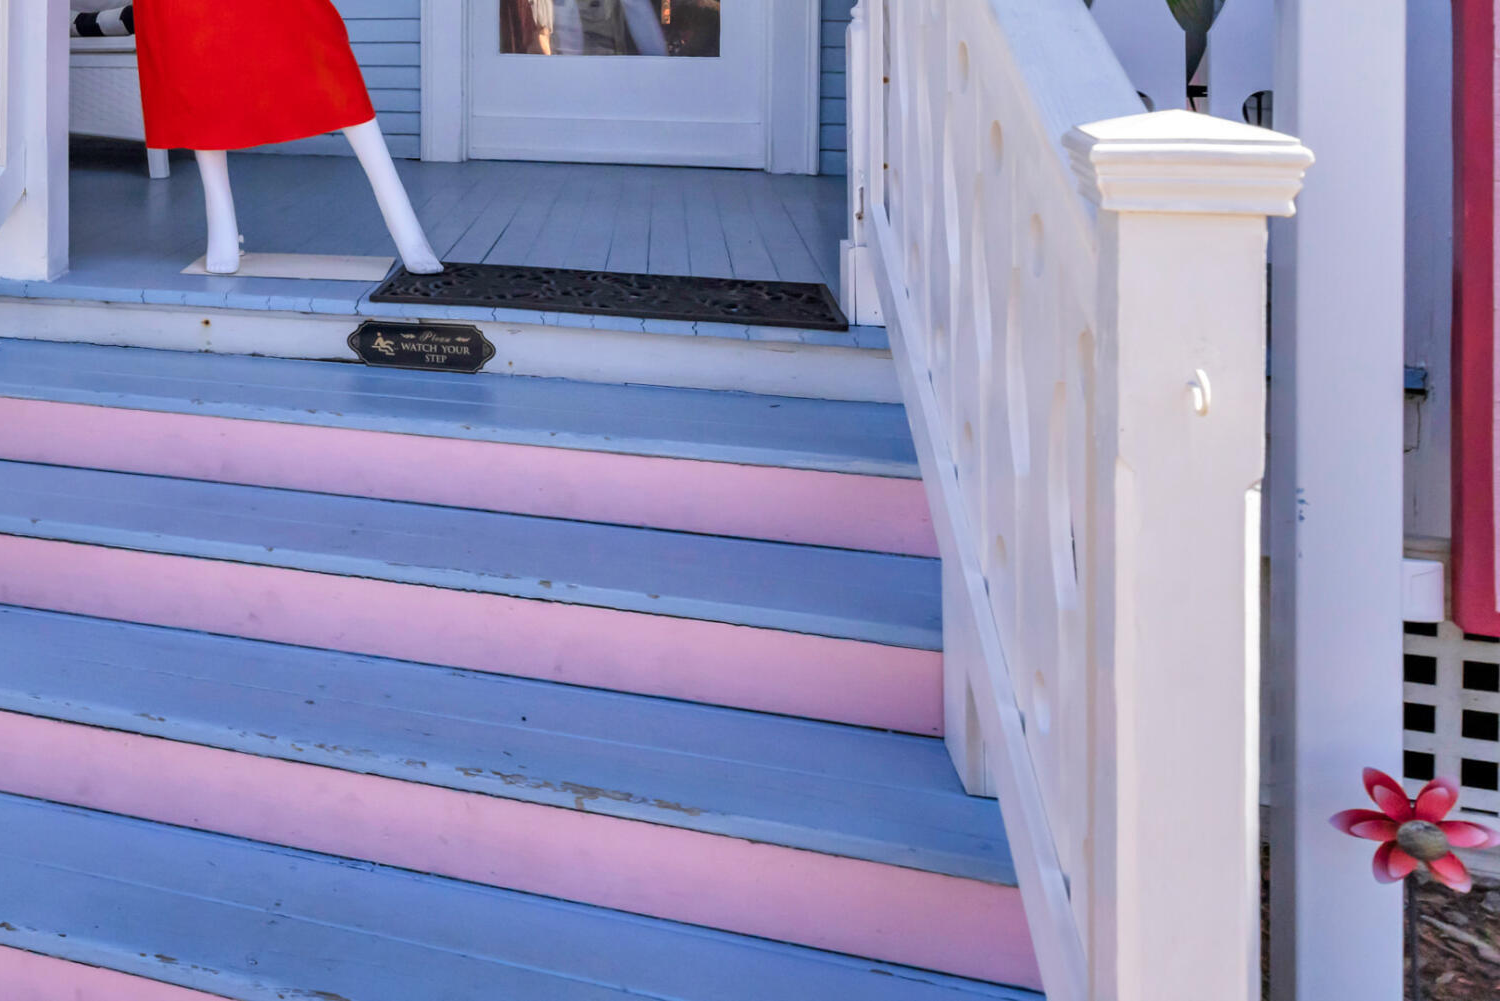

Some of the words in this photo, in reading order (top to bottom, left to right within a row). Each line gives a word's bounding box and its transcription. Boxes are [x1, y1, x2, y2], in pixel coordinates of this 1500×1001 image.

[401, 342, 437, 352] WATCH
[441, 345, 470, 355] YOUR
[425, 353, 447, 363] STEP
